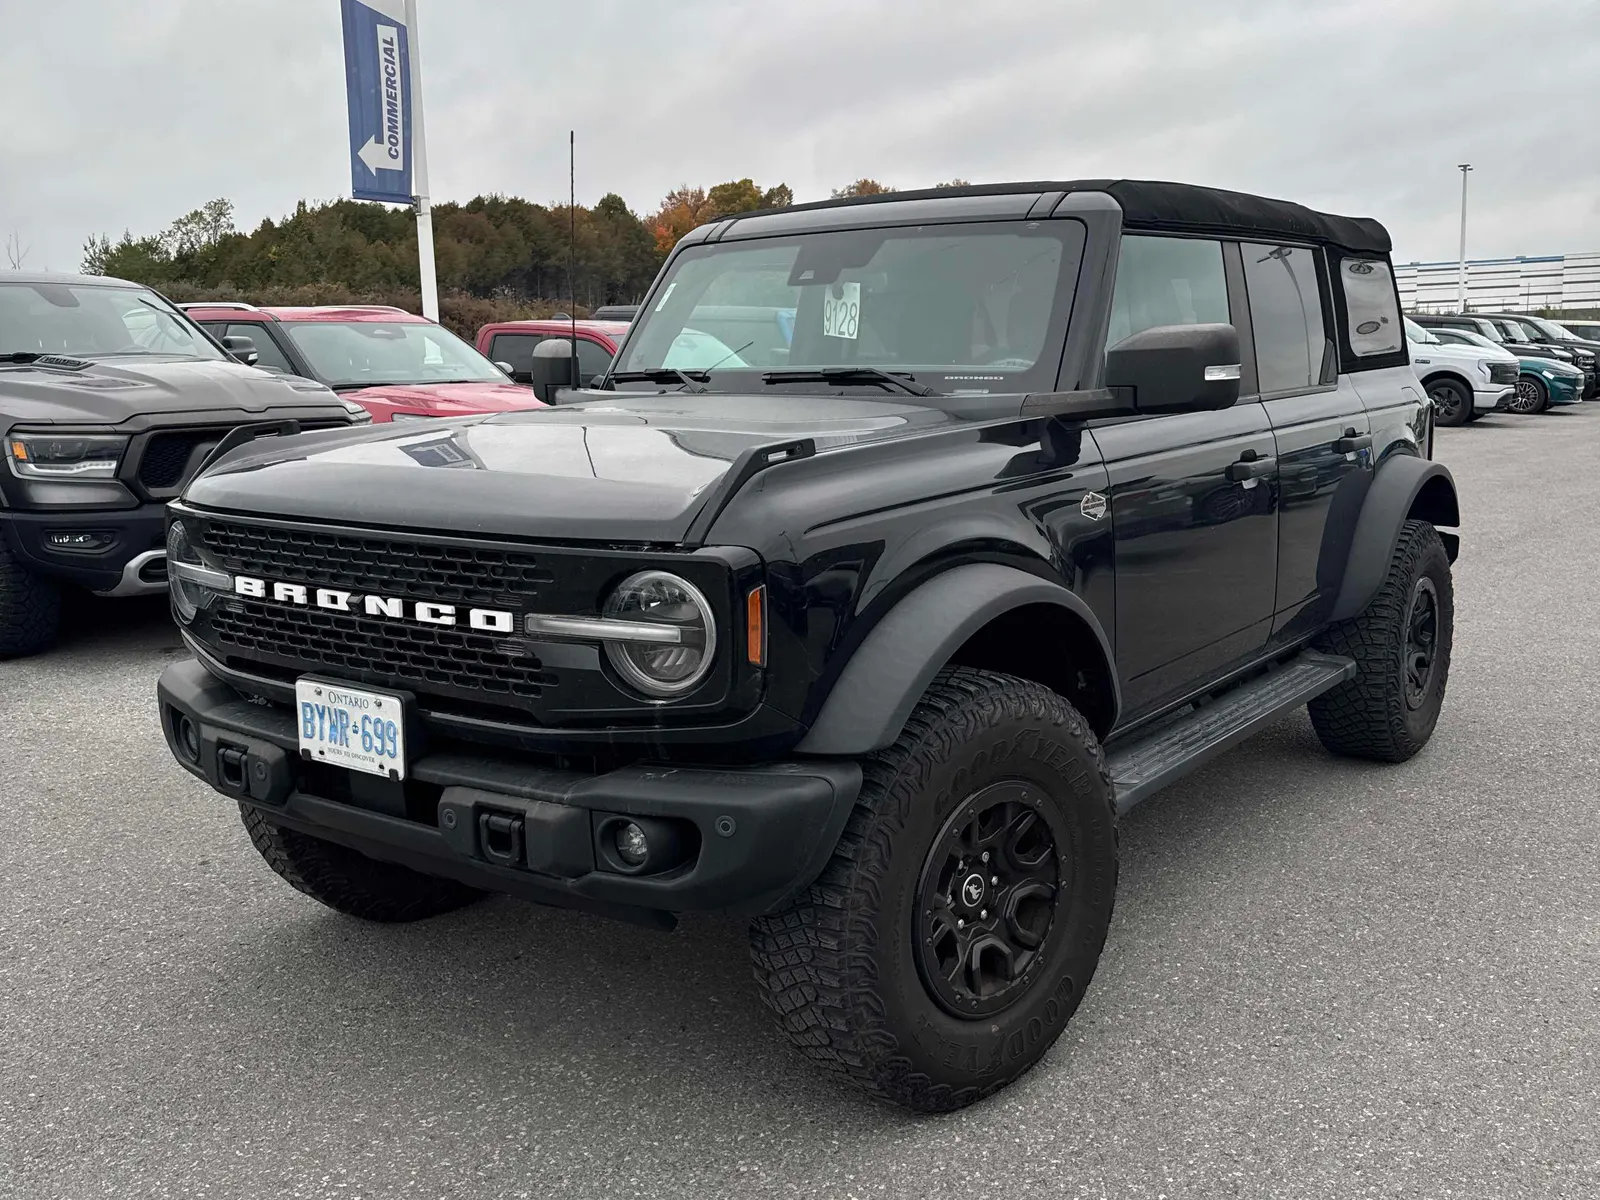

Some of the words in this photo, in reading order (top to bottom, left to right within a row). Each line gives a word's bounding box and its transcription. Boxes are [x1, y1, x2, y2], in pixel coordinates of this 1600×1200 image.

[382, 36, 399, 160] COMMERCIAL
[825, 300, 858, 337] 9128
[235, 576, 513, 633] BRONCO
[328, 691, 369, 709] ONTARIO
[302, 702, 349, 748] BYWR
[361, 714, 397, 759] 699
[351, 753, 375, 763] DISCOVER
